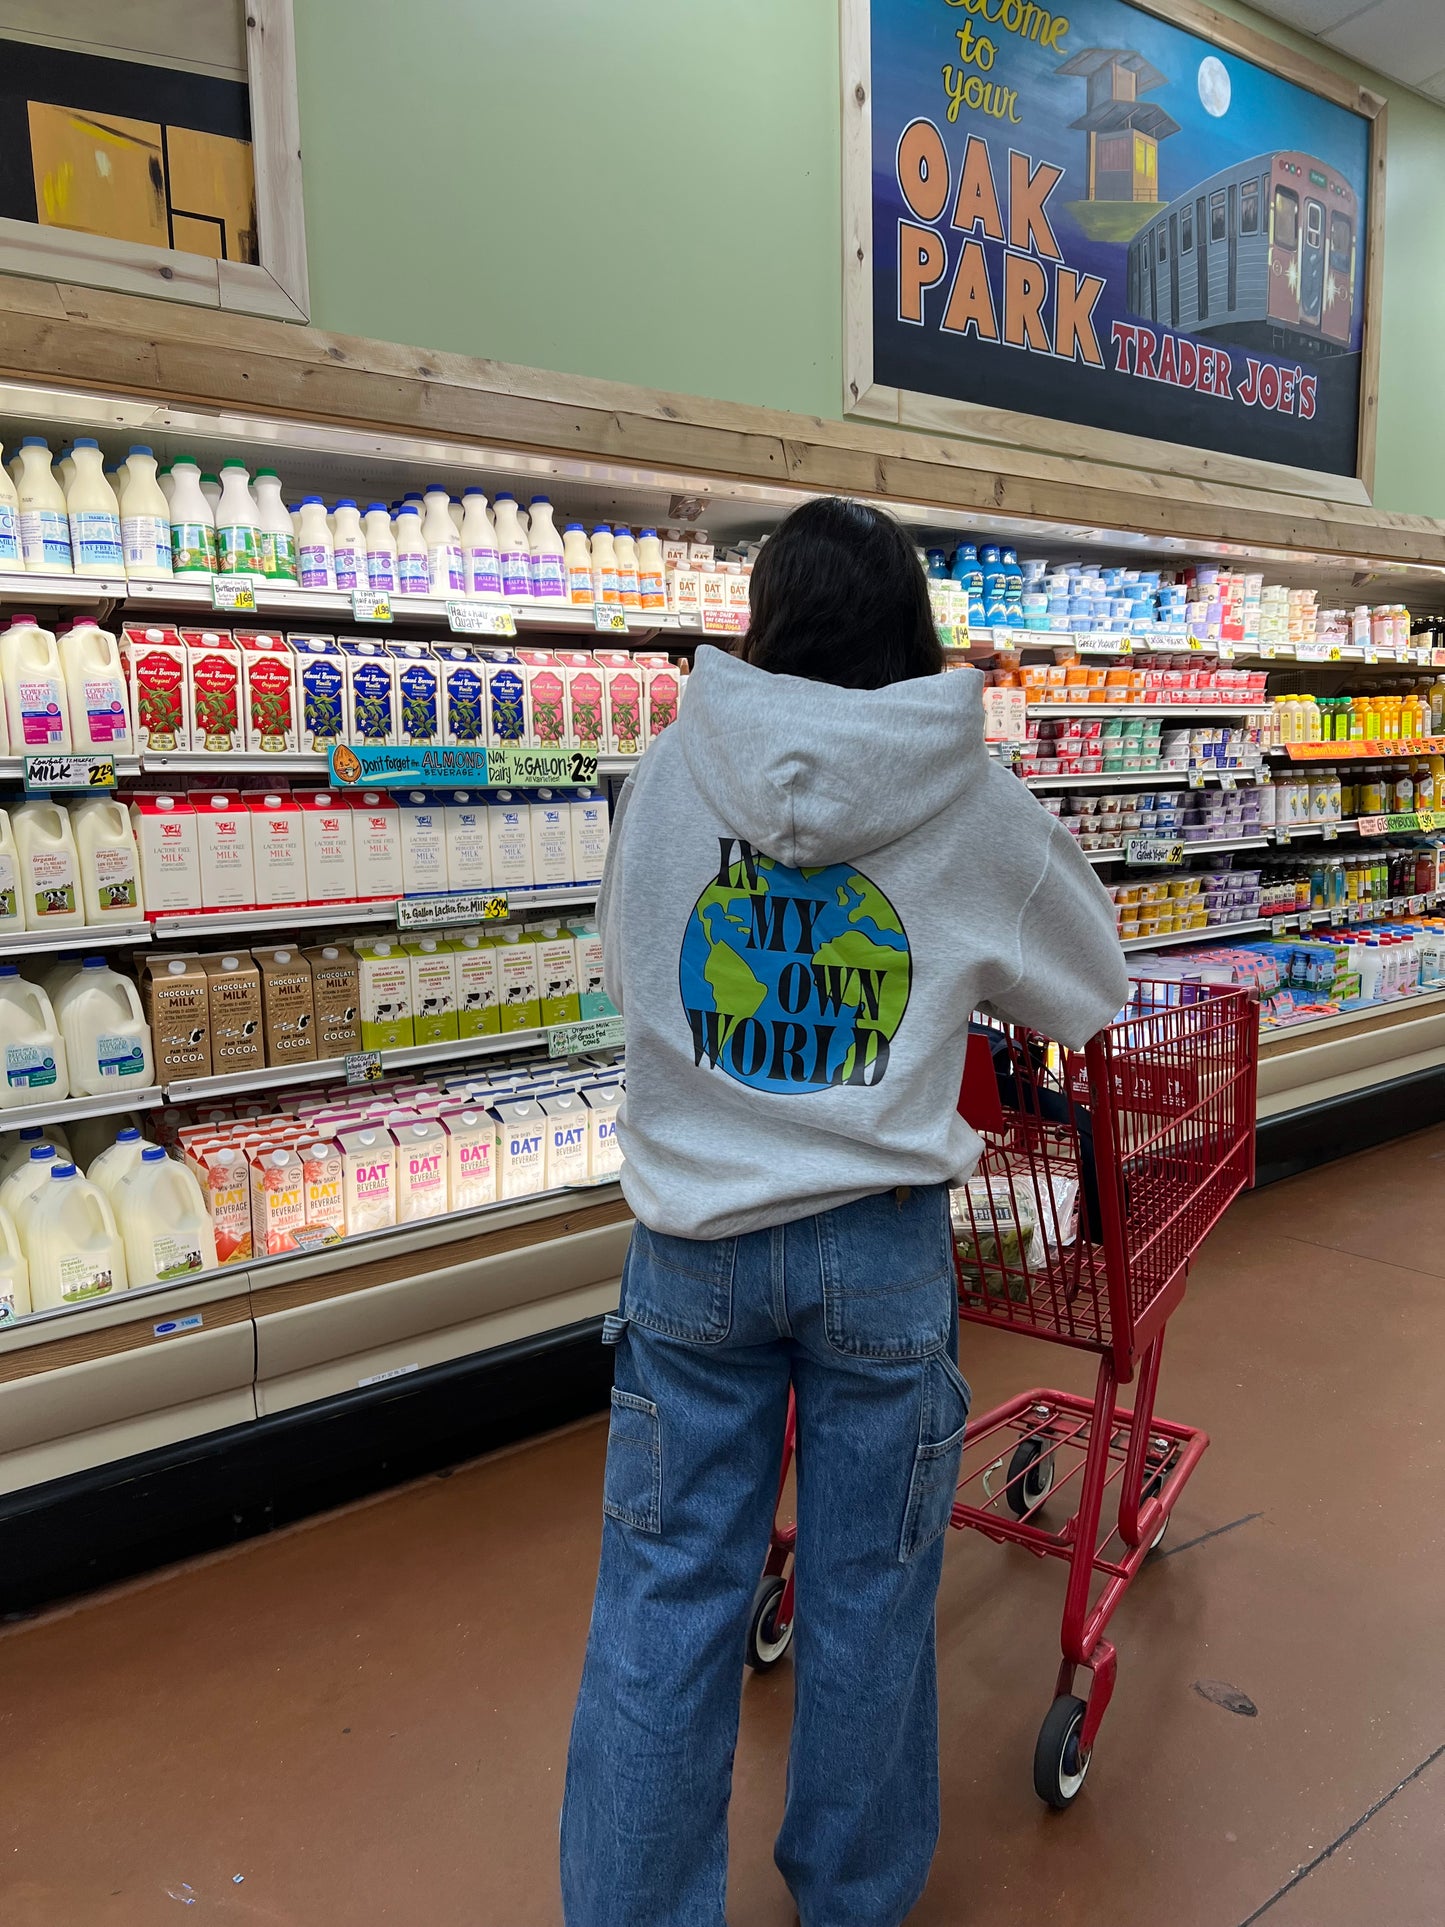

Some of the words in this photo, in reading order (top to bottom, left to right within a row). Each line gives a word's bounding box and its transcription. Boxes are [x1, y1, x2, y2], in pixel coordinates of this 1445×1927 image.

[956, 19, 999, 71] to
[942, 64, 1023, 124] your
[896, 116, 1066, 264] OAK
[897, 218, 1107, 370] PARK
[1111, 321, 1233, 400] TRADER
[1237, 357, 1317, 420] JOE'S
[680, 582, 696, 591] OAT
[705, 584, 721, 593] OAT
[730, 586, 746, 595] OAT
[454, 617, 482, 628] Quart
[1078, 639, 1097, 648] GREEK
[1097, 640, 1120, 649] YOGURT
[138, 667, 157, 675] Almond
[158, 668, 180, 679] Beverage
[195, 670, 214, 678] Almond
[215, 670, 236, 681] Beverage
[250, 672, 268, 680] Almond
[269, 672, 289, 683] Beverage
[150, 676, 171, 684] Original
[206, 679, 226, 687] Original
[361, 756, 384, 774] Don't
[385, 755, 411, 772] forget
[421, 751, 485, 768] ALMOND
[524, 757, 568, 776] GALLON
[567, 753, 598, 782] $2.99
[28, 764, 72, 781] MILK
[488, 766, 512, 784] Dairy
[321, 847, 341, 855] MILK
[1140, 841, 1148, 850] Fat
[96, 852, 119, 860] Organic
[161, 854, 184, 862] MILK
[216, 851, 238, 859] MILK
[270, 850, 291, 858] MILK
[416, 852, 435, 860] MILK
[1136, 850, 1152, 861] Greek
[32, 856, 58, 864] Organic
[715, 837, 762, 890] IN
[412, 906, 434, 918] Gallon
[435, 904, 456, 917] Lactose
[457, 902, 470, 913] Free
[470, 901, 490, 911] Milk
[745, 894, 828, 954] MY
[316, 971, 355, 980] CHOCOLATE
[212, 982, 256, 992] CHOCOLATE
[269, 977, 308, 987] CHOCOLATE
[326, 978, 348, 988] MILK
[158, 988, 204, 998] CHOCOLATE
[223, 990, 248, 1000] MILK
[278, 985, 301, 995] MILK
[778, 962, 888, 1021] OWN
[169, 997, 195, 1007] MILK
[571, 1024, 595, 1035] Organic
[577, 1032, 595, 1041] Grass
[595, 1029, 606, 1037] Fed
[323, 1030, 356, 1041] COCOA
[276, 1038, 311, 1049] COCOA
[687, 1008, 890, 1087] WORLD
[220, 1045, 258, 1056] COCOA
[165, 1053, 205, 1064] COCOA
[554, 1127, 585, 1147] OAT
[510, 1136, 542, 1156] OAT
[556, 1143, 582, 1157] BEVERAGE
[460, 1144, 491, 1163] OAT
[409, 1155, 442, 1175] OAT
[511, 1153, 539, 1166] BEVERAGE
[461, 1159, 490, 1172] BEVERAGE
[356, 1163, 390, 1183] OAT
[410, 1170, 440, 1183] BEVERAGE
[356, 1178, 389, 1192] BEVERAGE
[309, 1182, 340, 1200] OAT
[214, 1189, 246, 1207] OAT
[269, 1190, 301, 1208] OAT
[310, 1195, 341, 1209] BEVERAGE
[215, 1202, 248, 1216] BEVERAGE
[271, 1203, 303, 1218] BEVERAGE
